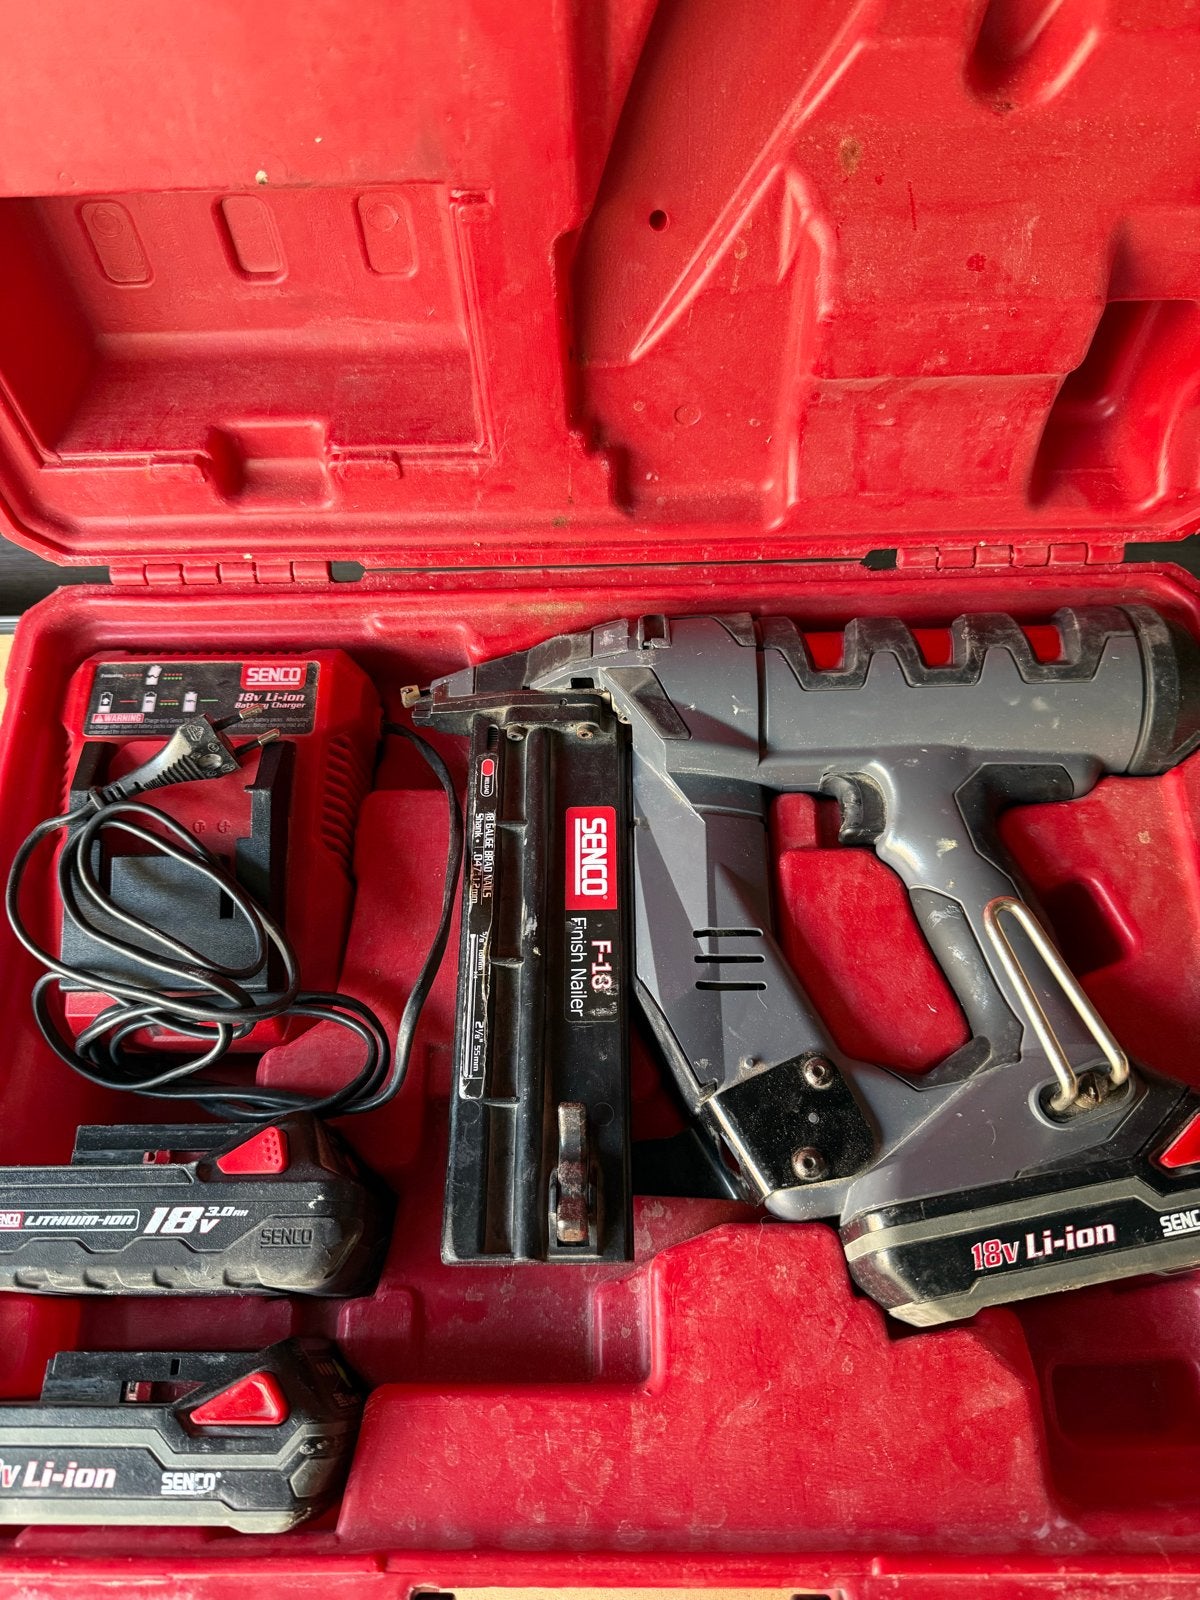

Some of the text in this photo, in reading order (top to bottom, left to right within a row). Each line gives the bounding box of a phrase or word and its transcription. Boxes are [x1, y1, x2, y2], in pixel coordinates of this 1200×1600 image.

[247, 667, 302, 681] SENCO
[238, 692, 305, 702] 18v Li-ion
[271, 702, 306, 710] Charger
[104, 714, 144, 723] WARNING
[475, 812, 485, 838] Shank
[483, 850, 494, 873] BRAD
[581, 817, 608, 896] SENCO
[482, 874, 493, 898] NAILS
[570, 917, 588, 1017] Finish Nailer
[591, 940, 613, 990] F-18
[473, 1045, 481, 1072] 55mm
[25, 1214, 135, 1226] LITHIUM-ION
[260, 1228, 313, 1246] SENCO
[970, 1222, 1116, 1271] 18v Li-ion
[22, 1460, 117, 1489] Li-ion
